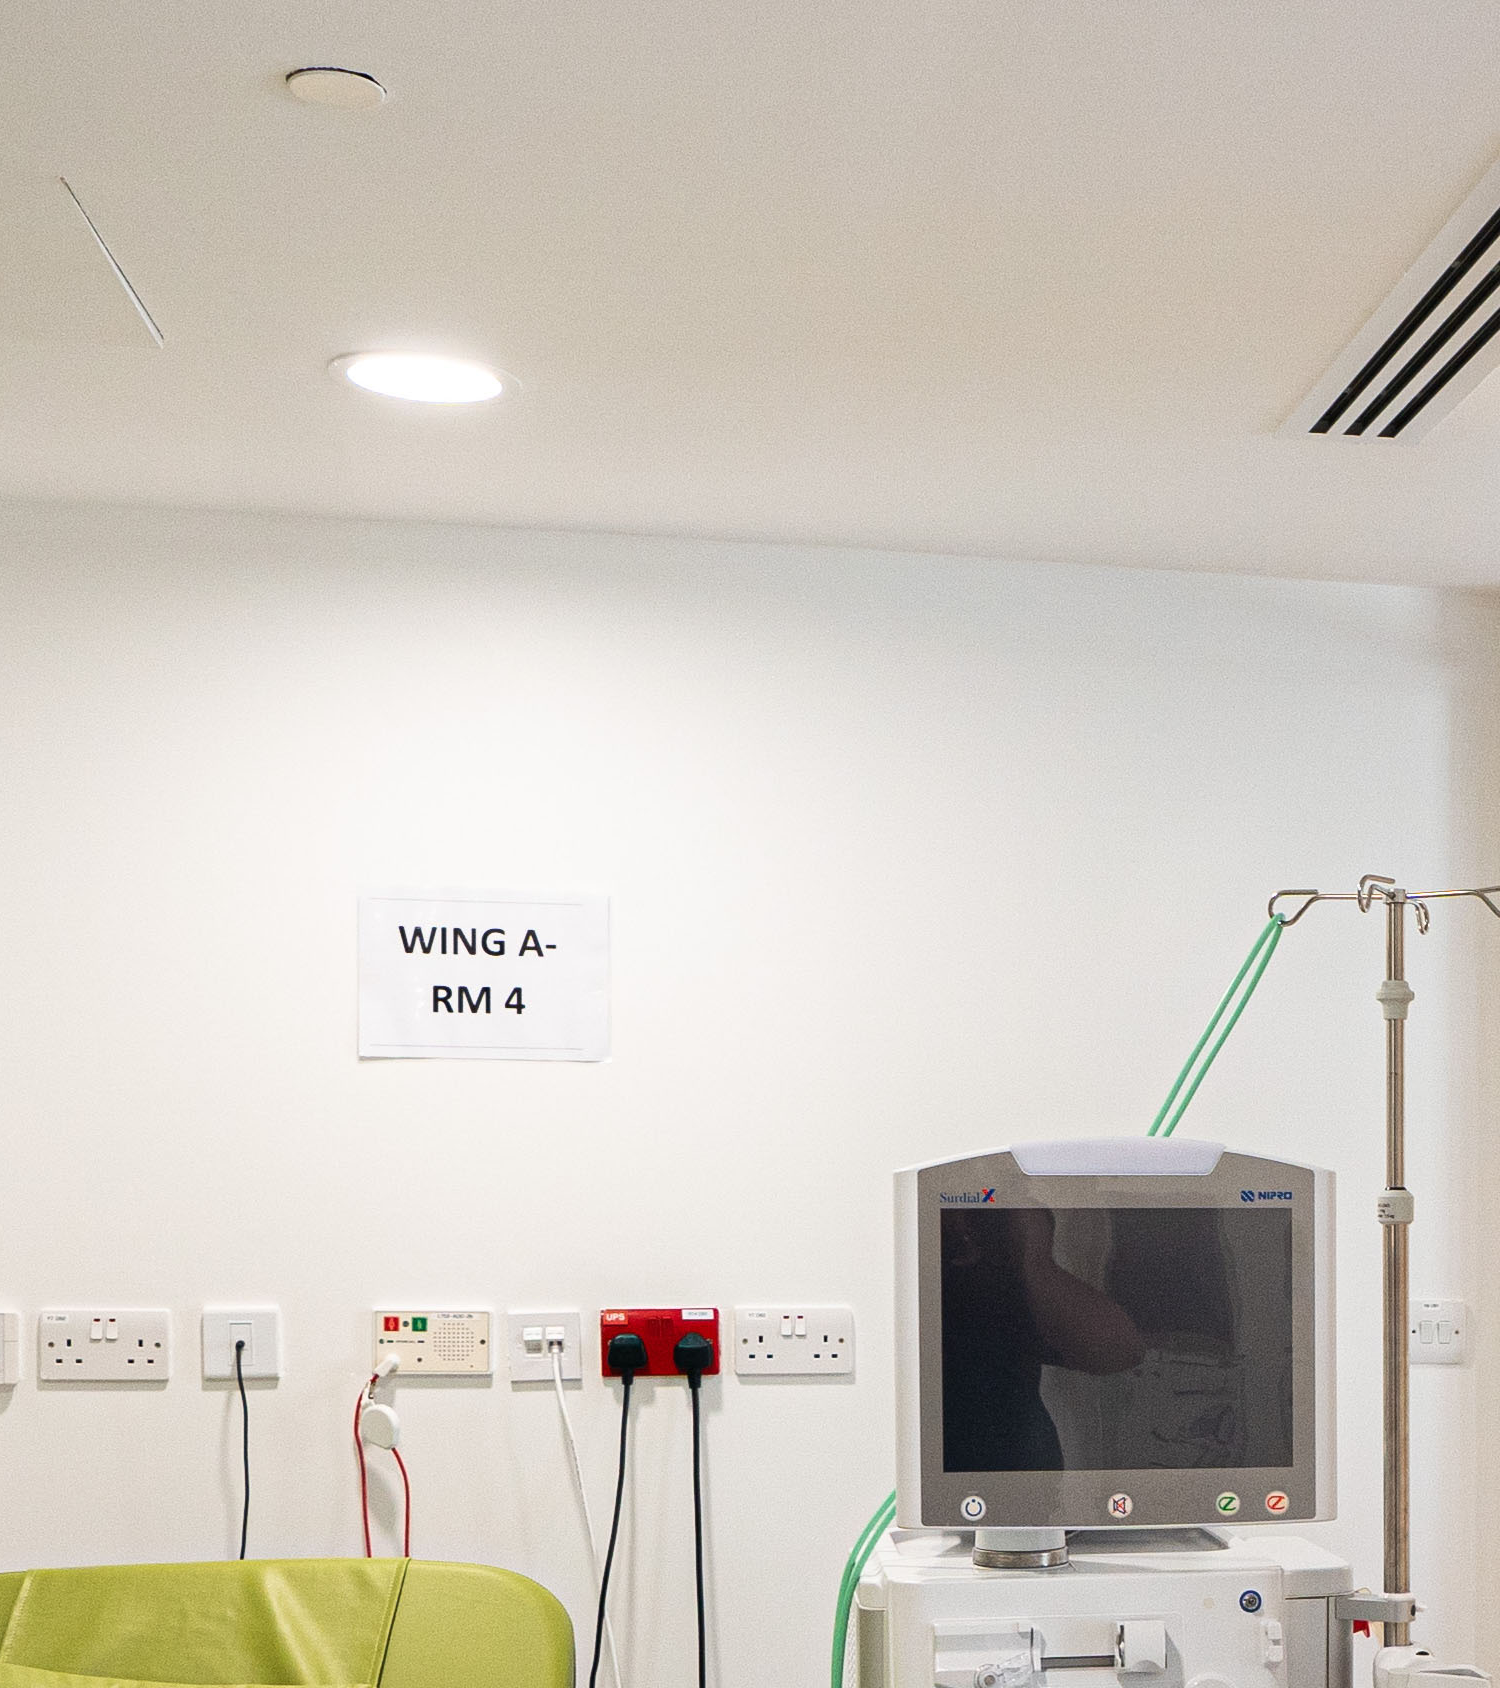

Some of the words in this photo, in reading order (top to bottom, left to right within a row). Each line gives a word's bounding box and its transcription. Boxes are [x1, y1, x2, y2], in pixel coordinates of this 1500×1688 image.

[398, 925, 506, 957] WING
[518, 929, 557, 957] A-
[431, 985, 492, 1014] RM
[504, 986, 526, 1015] 4
[939, 1191, 980, 1203] Surdial
[1257, 1191, 1293, 1200] NIPRO
[606, 1312, 626, 1322] UPS
